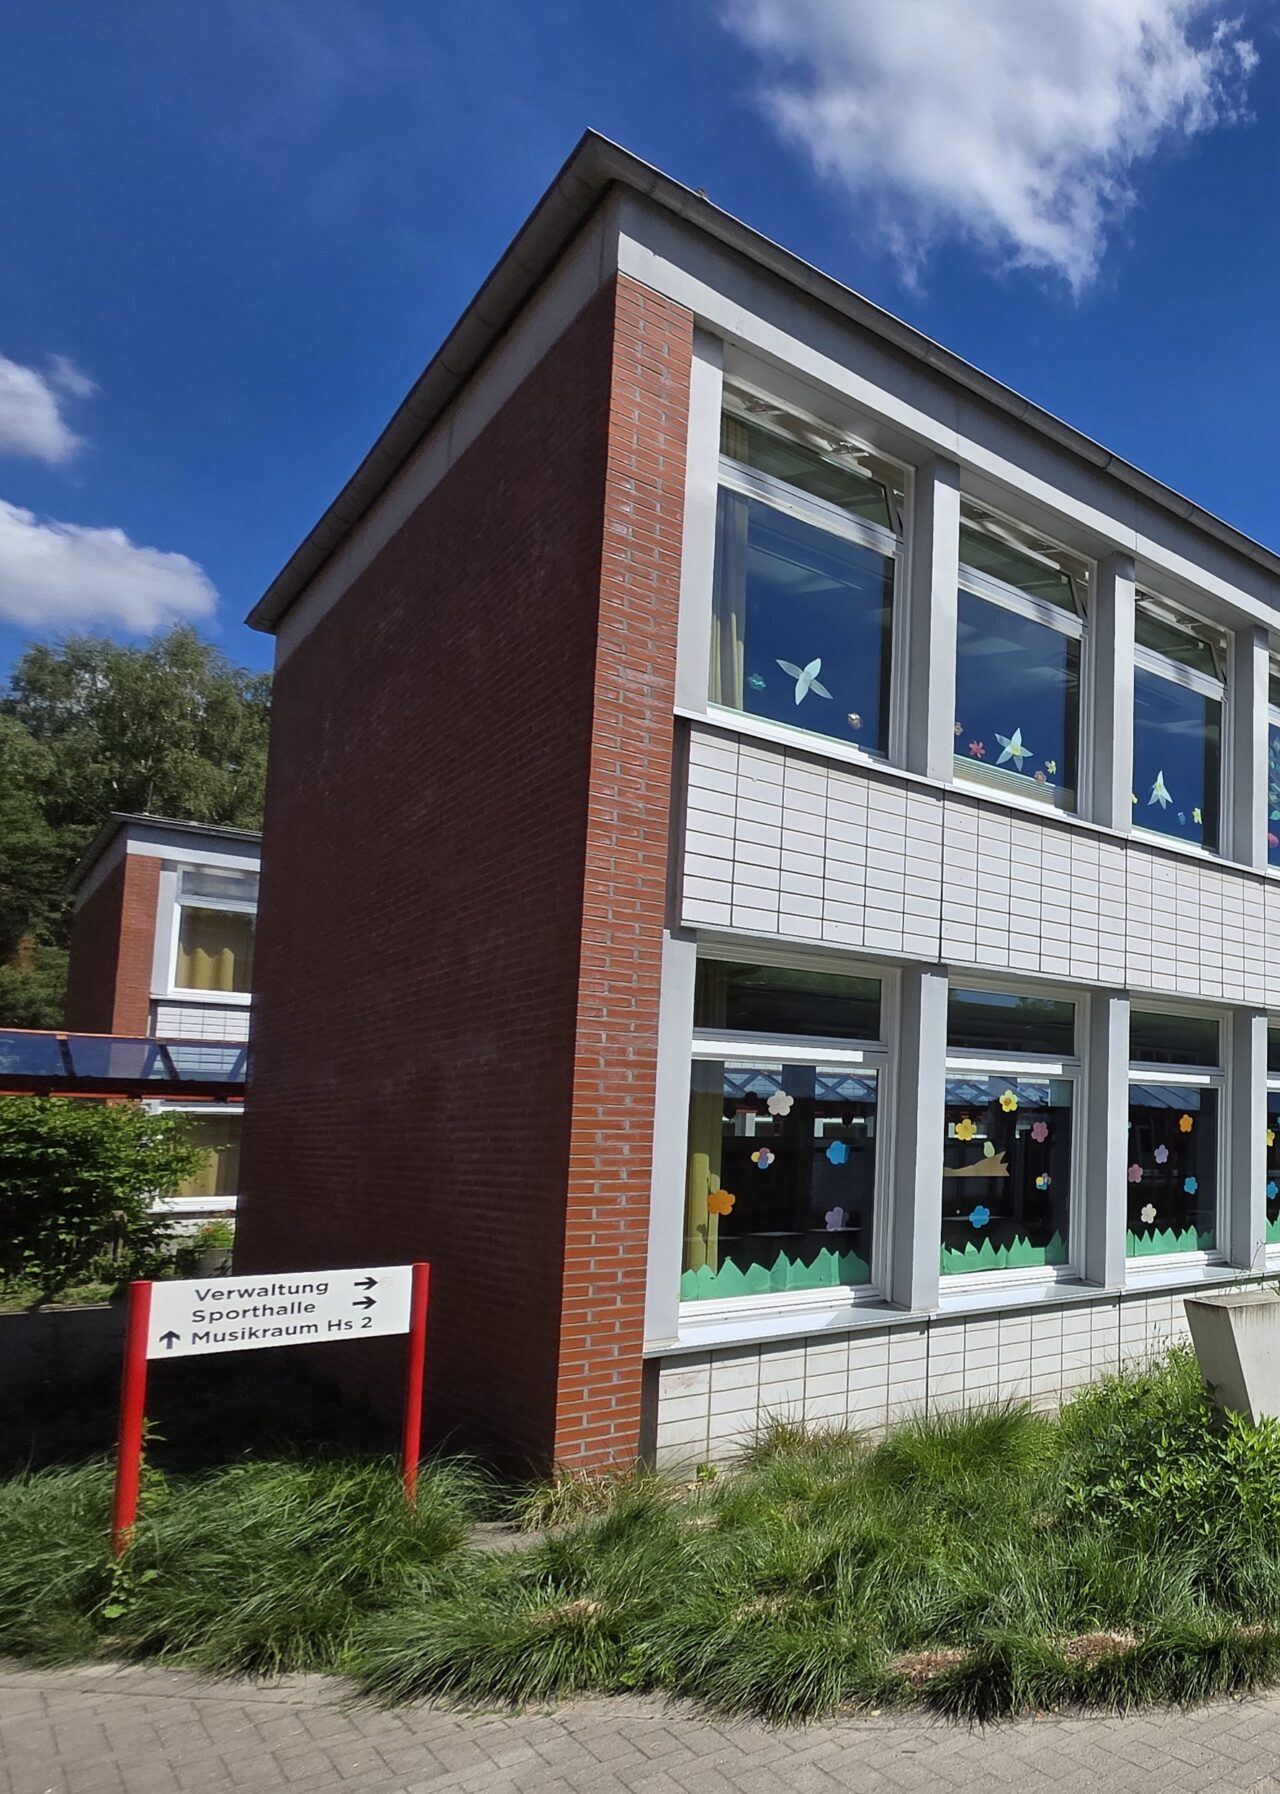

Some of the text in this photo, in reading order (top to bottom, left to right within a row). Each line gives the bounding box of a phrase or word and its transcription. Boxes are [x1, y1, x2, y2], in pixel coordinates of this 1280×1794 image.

[194, 1281, 330, 1302] Verwaltung
[191, 1301, 316, 1325] Sporthalle
[191, 1316, 373, 1345] Musikraum Hs 2
